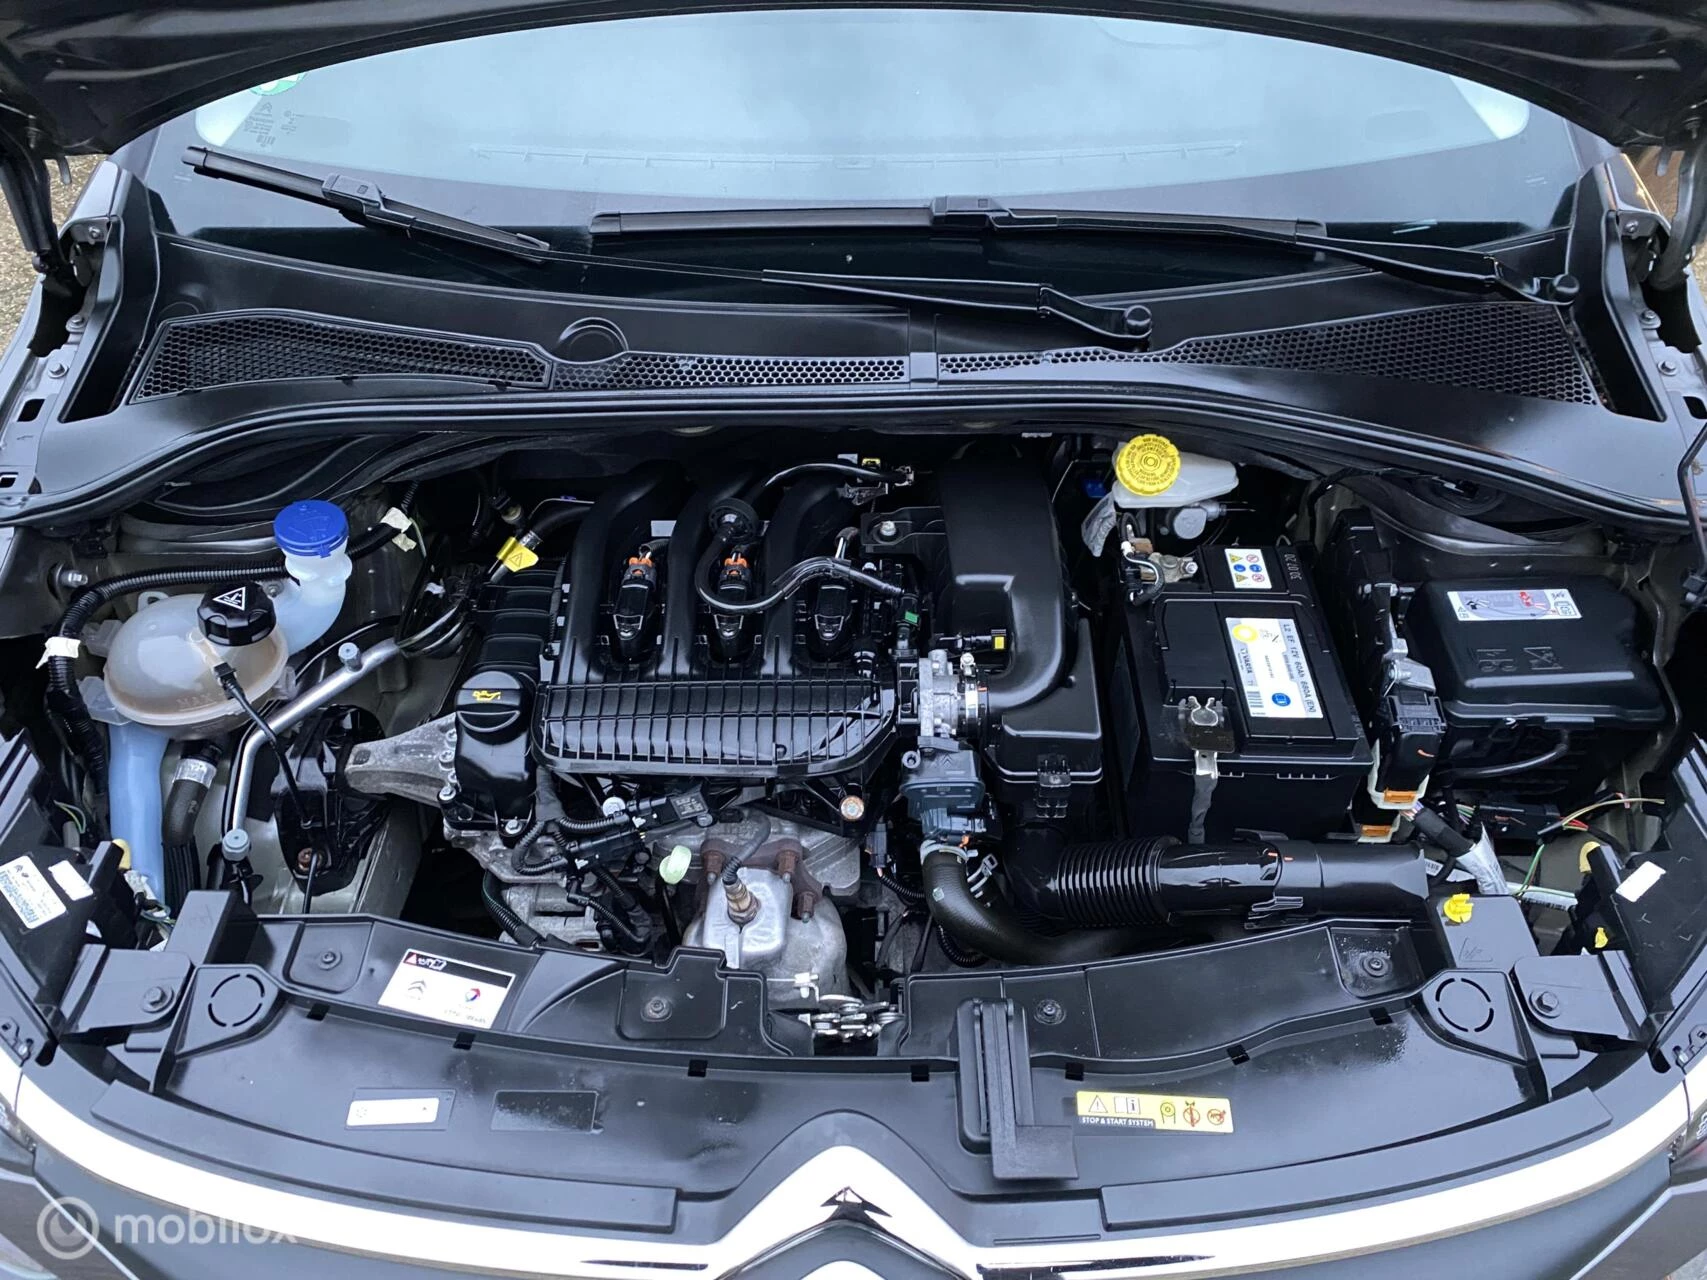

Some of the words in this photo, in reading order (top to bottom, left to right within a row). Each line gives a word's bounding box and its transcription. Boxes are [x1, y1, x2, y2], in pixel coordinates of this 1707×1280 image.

[1290, 646, 1300, 658] 12V
[1242, 654, 1253, 674] VARTA
[1081, 1116, 1100, 1124] STOP
[1100, 1117, 1106, 1125] &
[1106, 1117, 1127, 1126] START
[1127, 1118, 1154, 1127] SYSTEM
